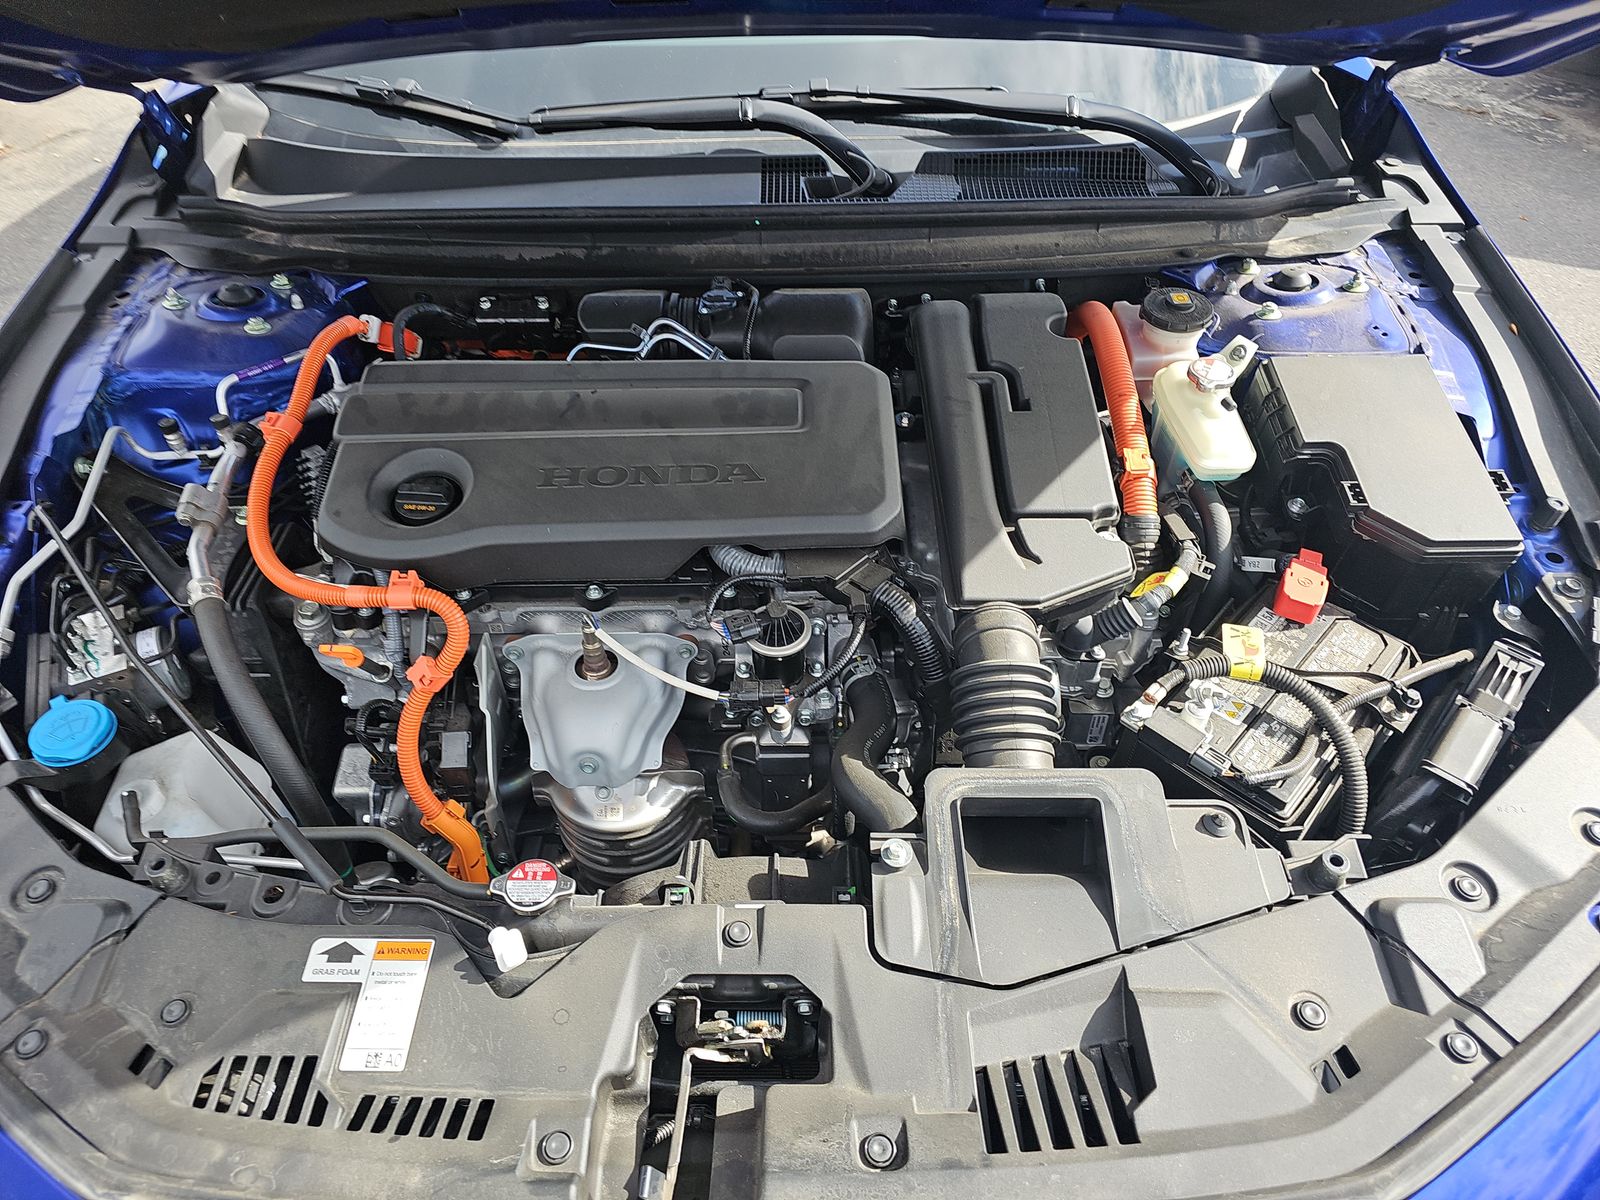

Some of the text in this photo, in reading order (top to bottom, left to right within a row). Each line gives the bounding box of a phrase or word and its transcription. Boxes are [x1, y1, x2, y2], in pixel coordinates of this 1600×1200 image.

[535, 461, 766, 489] HONDA
[386, 947, 428, 955] WARNING
[311, 968, 361, 976] GRAB FOAM
